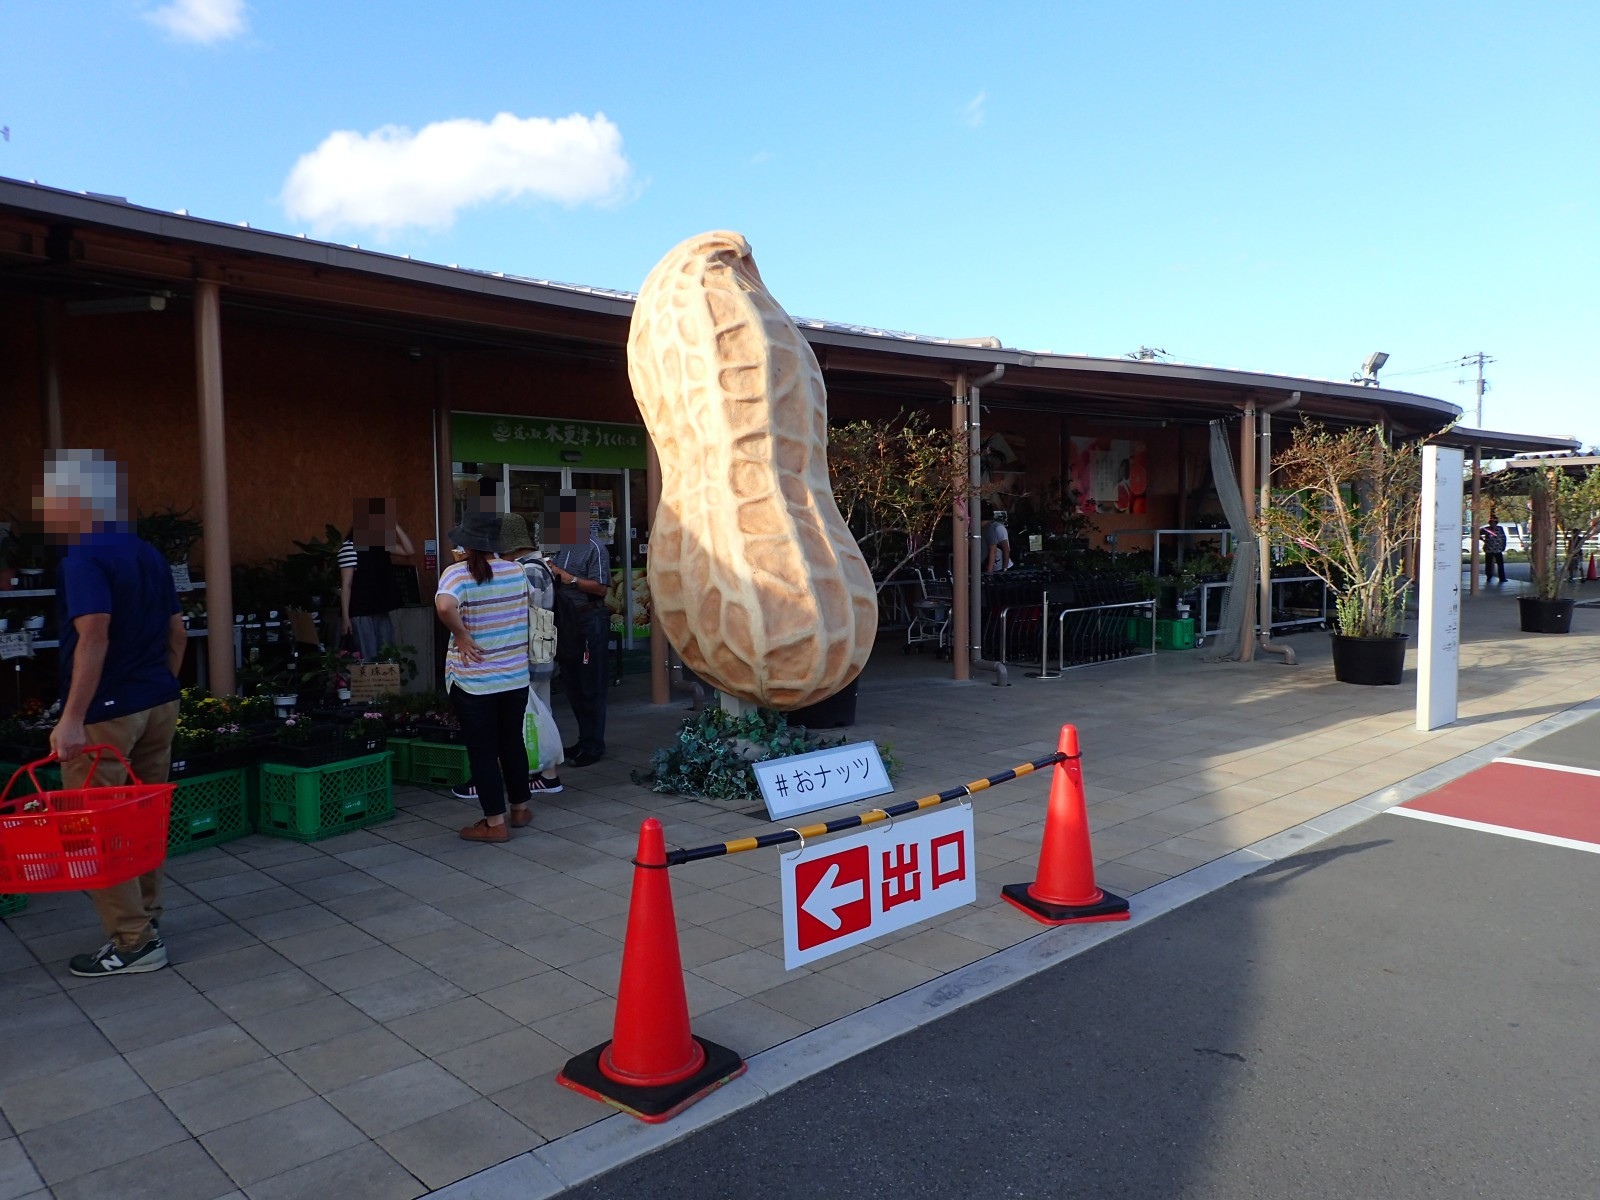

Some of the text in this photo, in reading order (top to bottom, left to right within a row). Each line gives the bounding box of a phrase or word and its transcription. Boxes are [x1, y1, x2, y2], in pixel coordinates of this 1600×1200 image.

[544, 423, 591, 447] 木更津
[775, 757, 870, 798] #おナッツ
[881, 829, 966, 912] 出口
[100, 954, 125, 972] N
